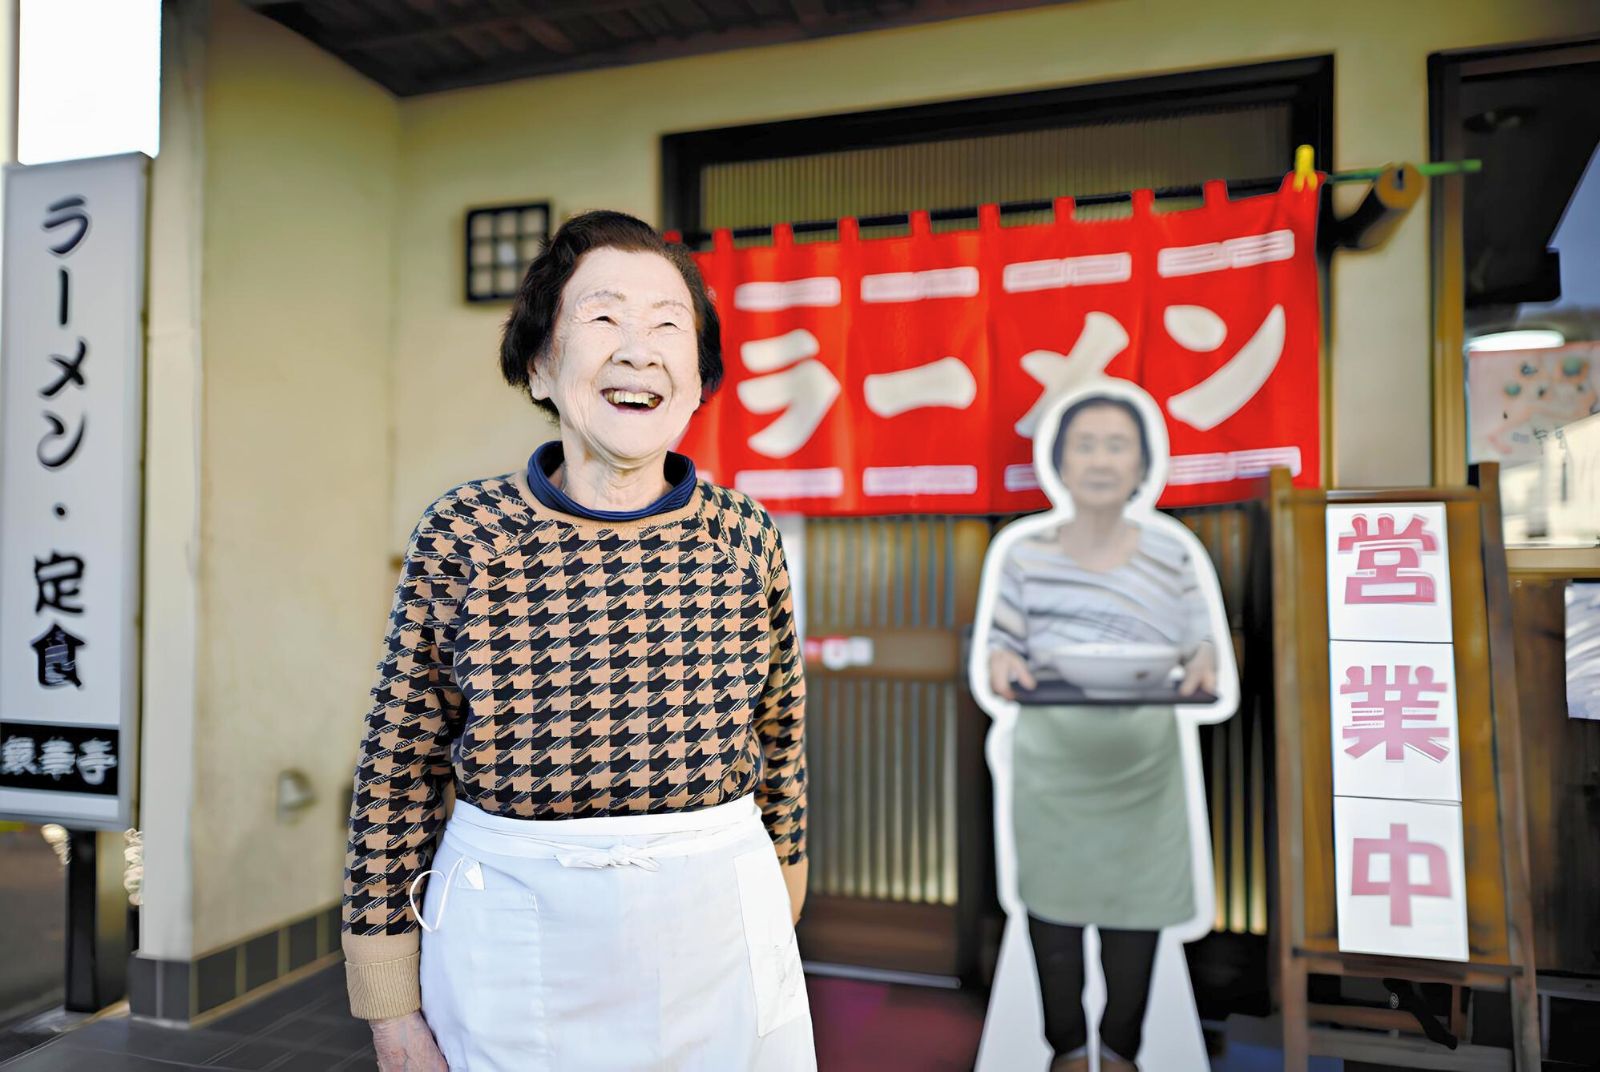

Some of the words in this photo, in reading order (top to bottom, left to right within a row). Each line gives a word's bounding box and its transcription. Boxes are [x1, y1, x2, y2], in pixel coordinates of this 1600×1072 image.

[736, 303, 1286, 458] ラーメン
[1337, 512, 1452, 928] 営業中
